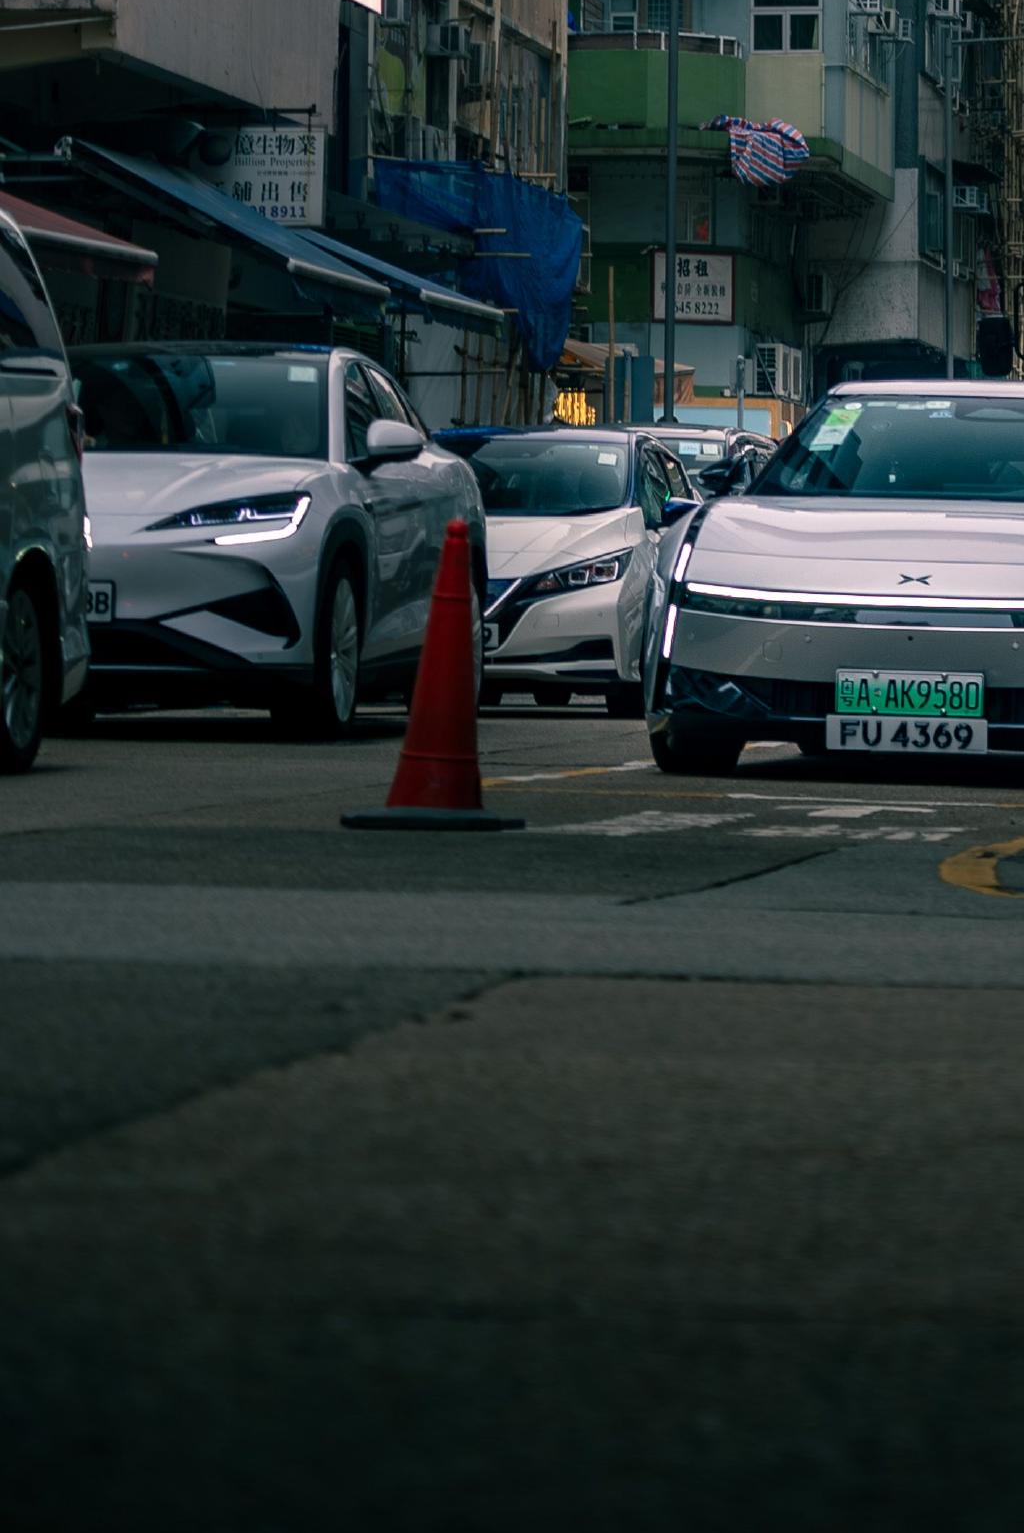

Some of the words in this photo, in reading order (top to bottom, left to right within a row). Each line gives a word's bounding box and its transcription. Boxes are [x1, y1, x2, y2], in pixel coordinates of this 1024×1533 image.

[234, 133, 317, 156] 億生物業
[270, 205, 306, 219] 8911
[676, 257, 709, 278] 招租
[694, 302, 720, 316] 8222
[884, 678, 981, 711] AK9580
[839, 719, 883, 747] FU
[890, 721, 974, 750] 4369
